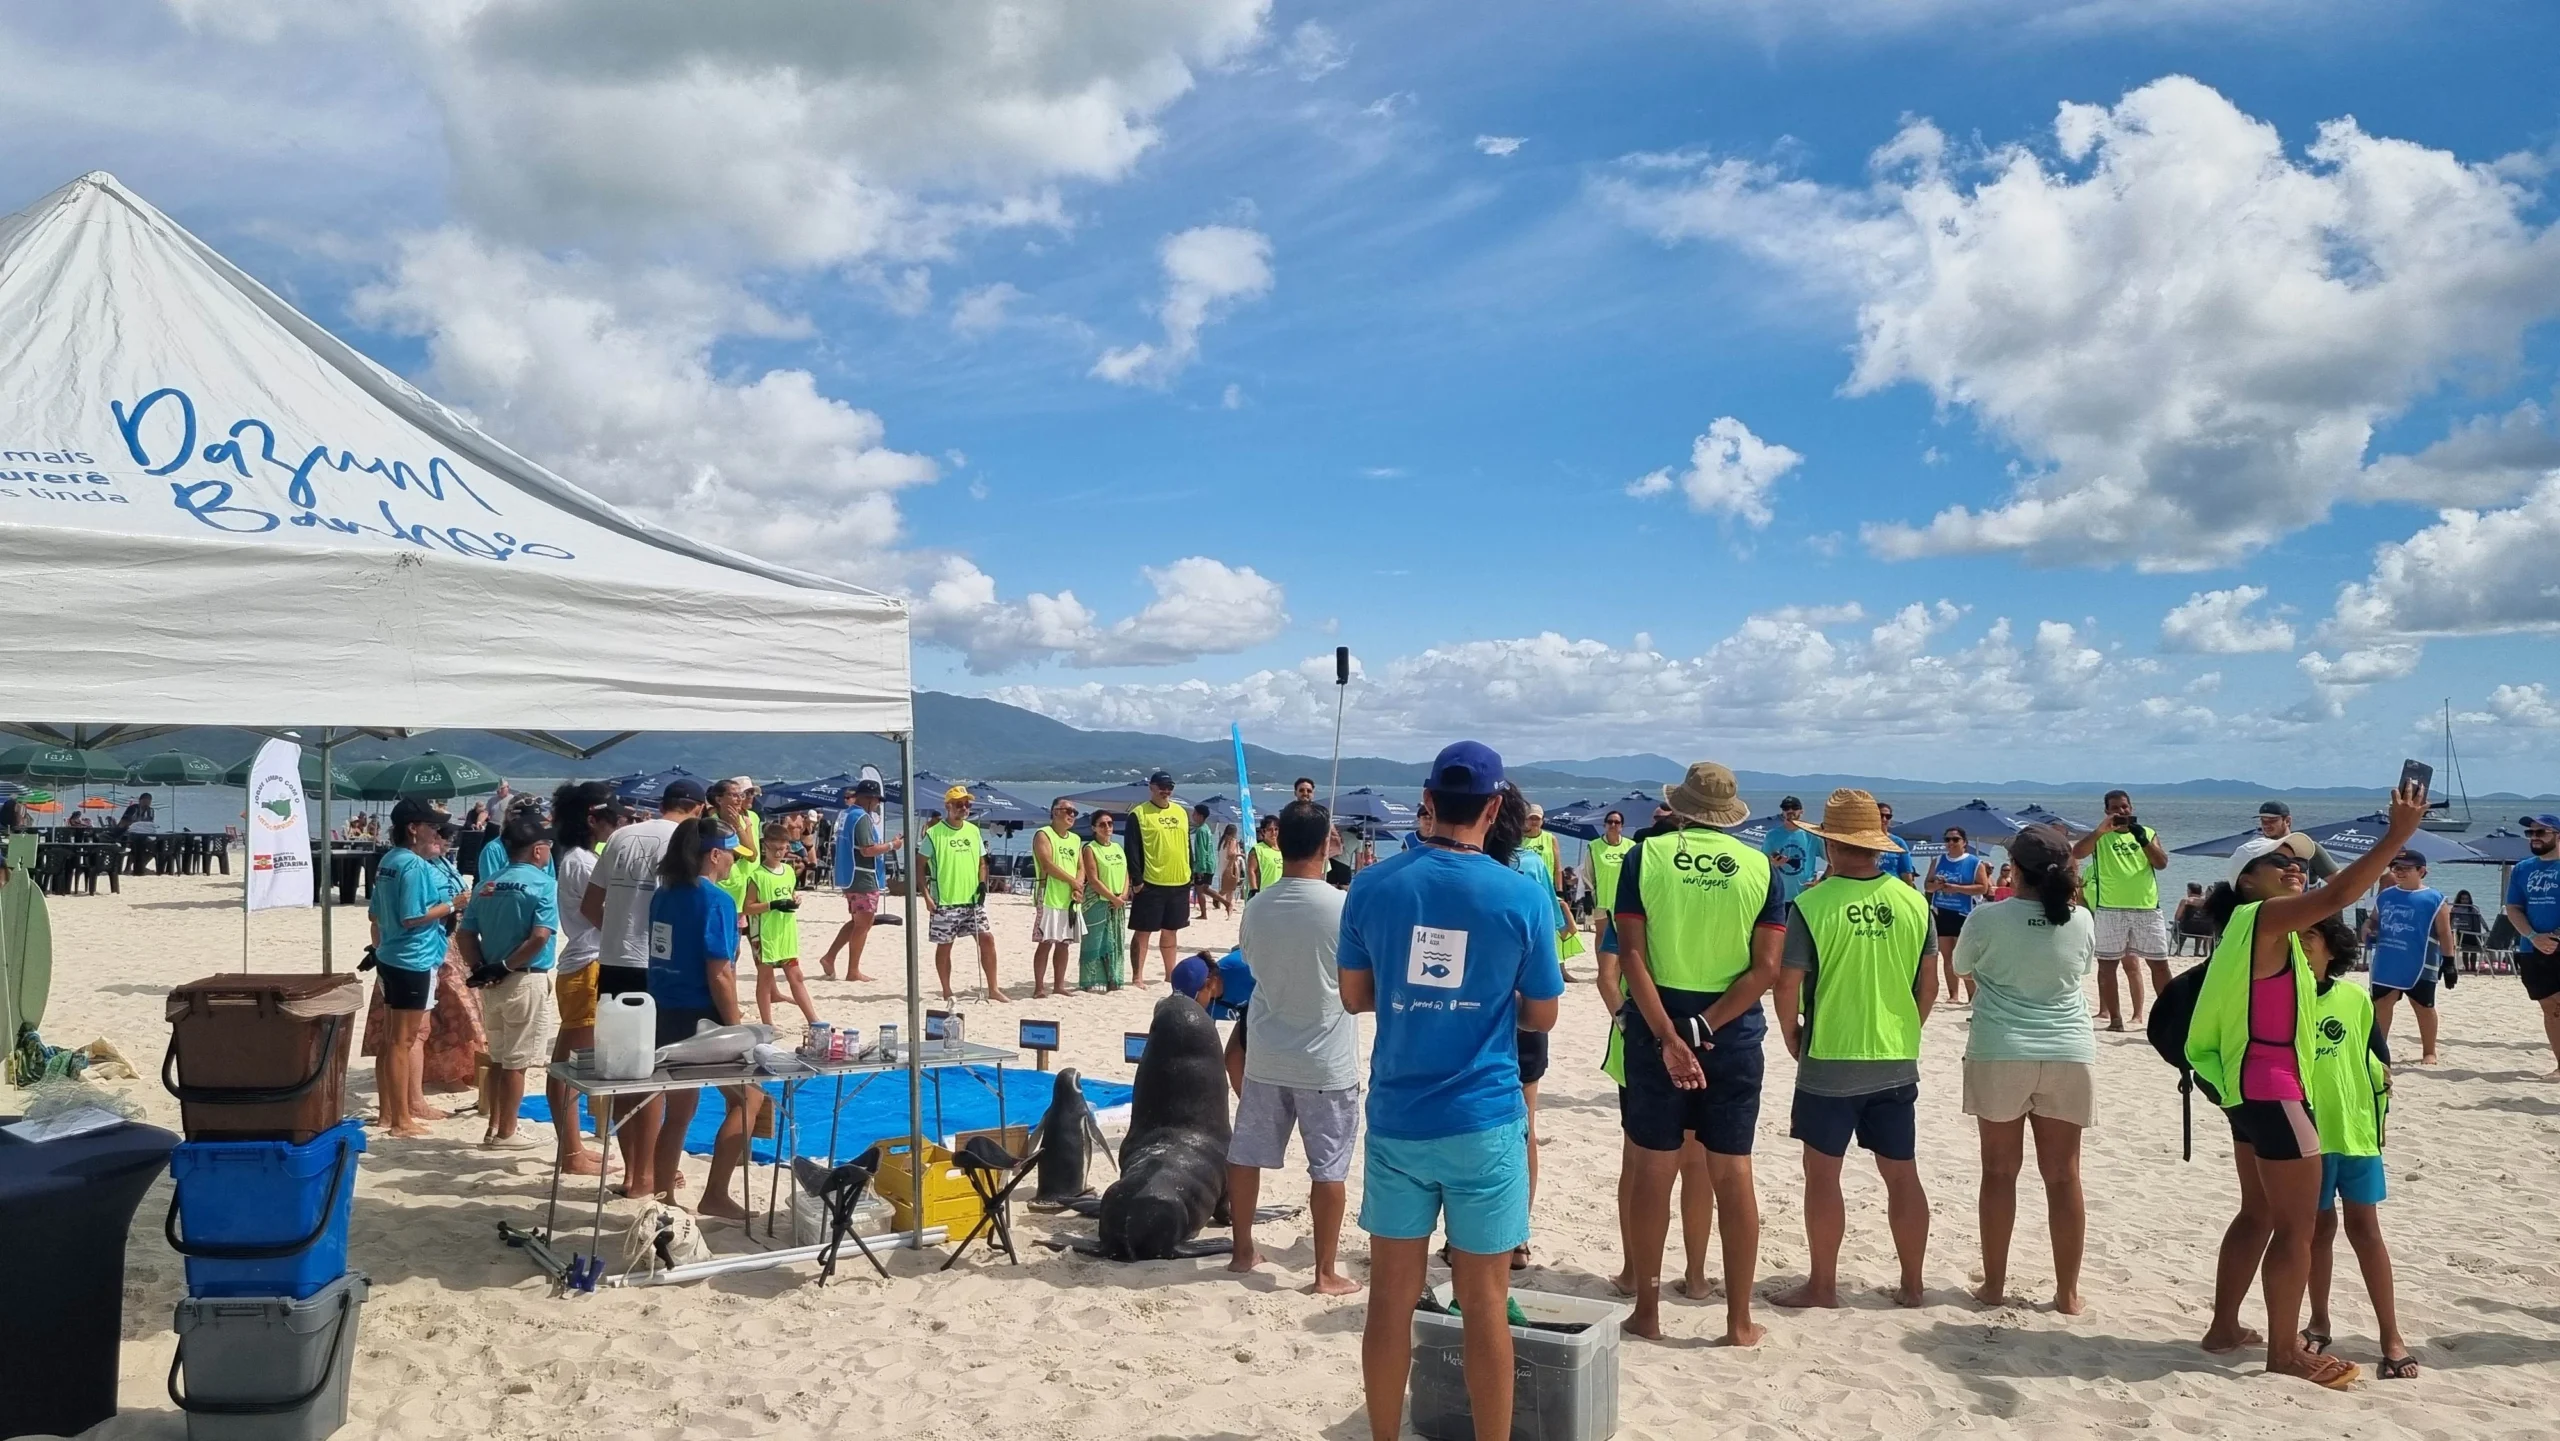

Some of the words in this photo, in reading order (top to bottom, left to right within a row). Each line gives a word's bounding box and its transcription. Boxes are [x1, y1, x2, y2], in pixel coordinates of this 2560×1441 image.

[3, 449, 95, 464] mais
[0, 471, 111, 485] urerê
[28, 488, 130, 504] linda
[273, 855, 296, 863] SANTA
[273, 861, 308, 869] CATARINA
[496, 882, 528, 892] SEMAE
[1682, 873, 1730, 891] vantagens
[1416, 931, 1427, 943] 14
